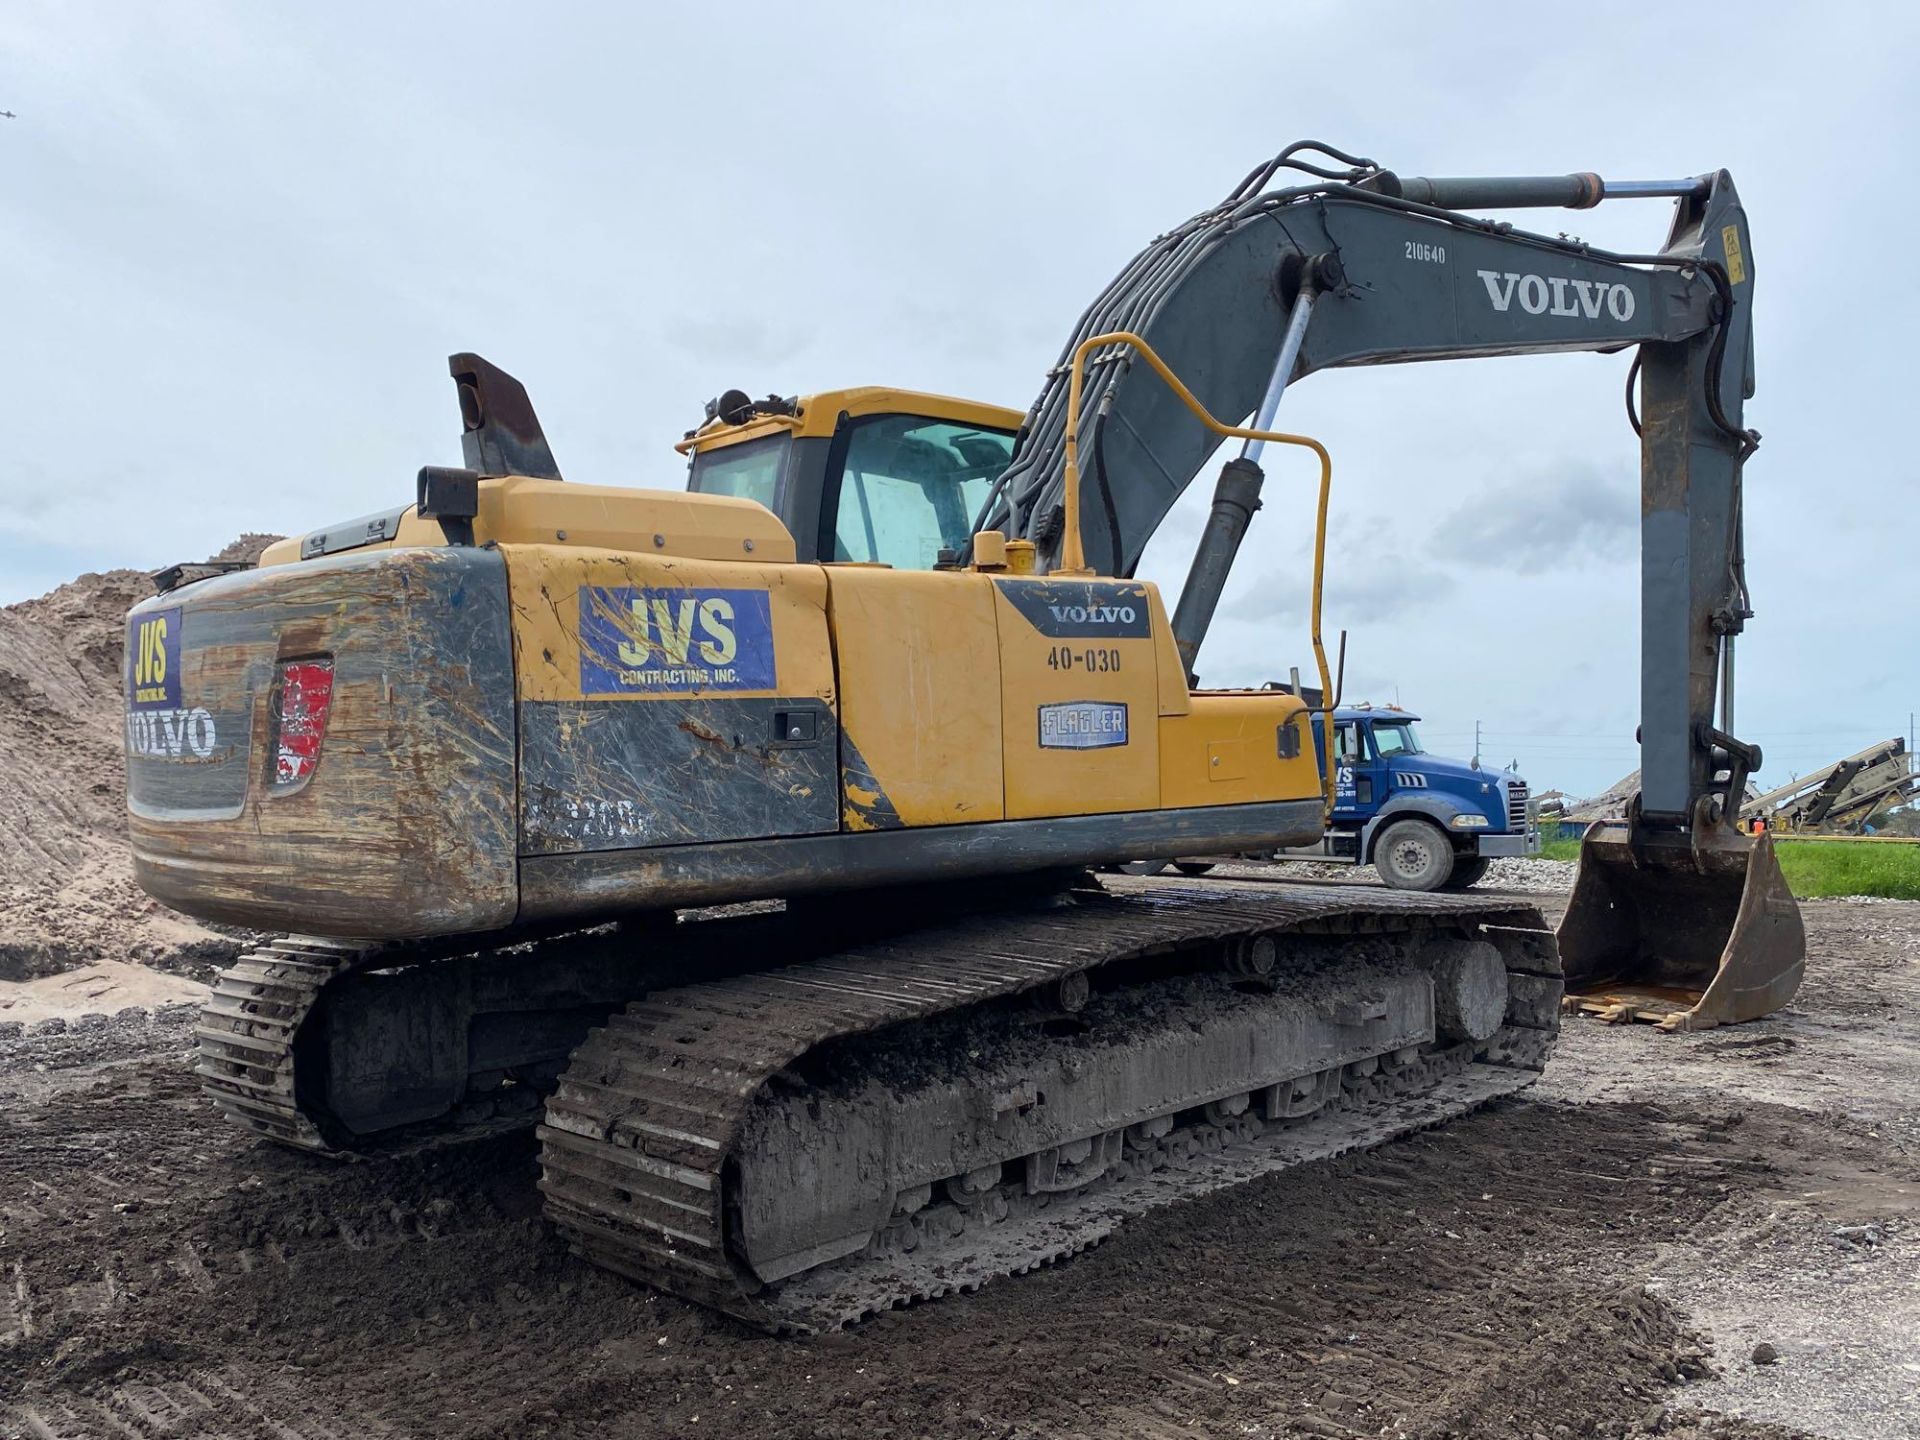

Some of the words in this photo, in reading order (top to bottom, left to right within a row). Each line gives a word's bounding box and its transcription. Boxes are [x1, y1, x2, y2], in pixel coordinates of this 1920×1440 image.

[1405, 241, 1445, 264] 210640
[1477, 270, 1635, 322] VOLVO
[1048, 605, 1136, 624] VOLVO
[618, 598, 736, 666] JVS
[135, 617, 167, 686] JVS
[1047, 646, 1120, 672] 40-030
[620, 669, 713, 685] CONTRACTING,
[714, 669, 740, 683] INC.
[126, 707, 216, 757] VOLVO
[1043, 709, 1123, 735] FLAGLER
